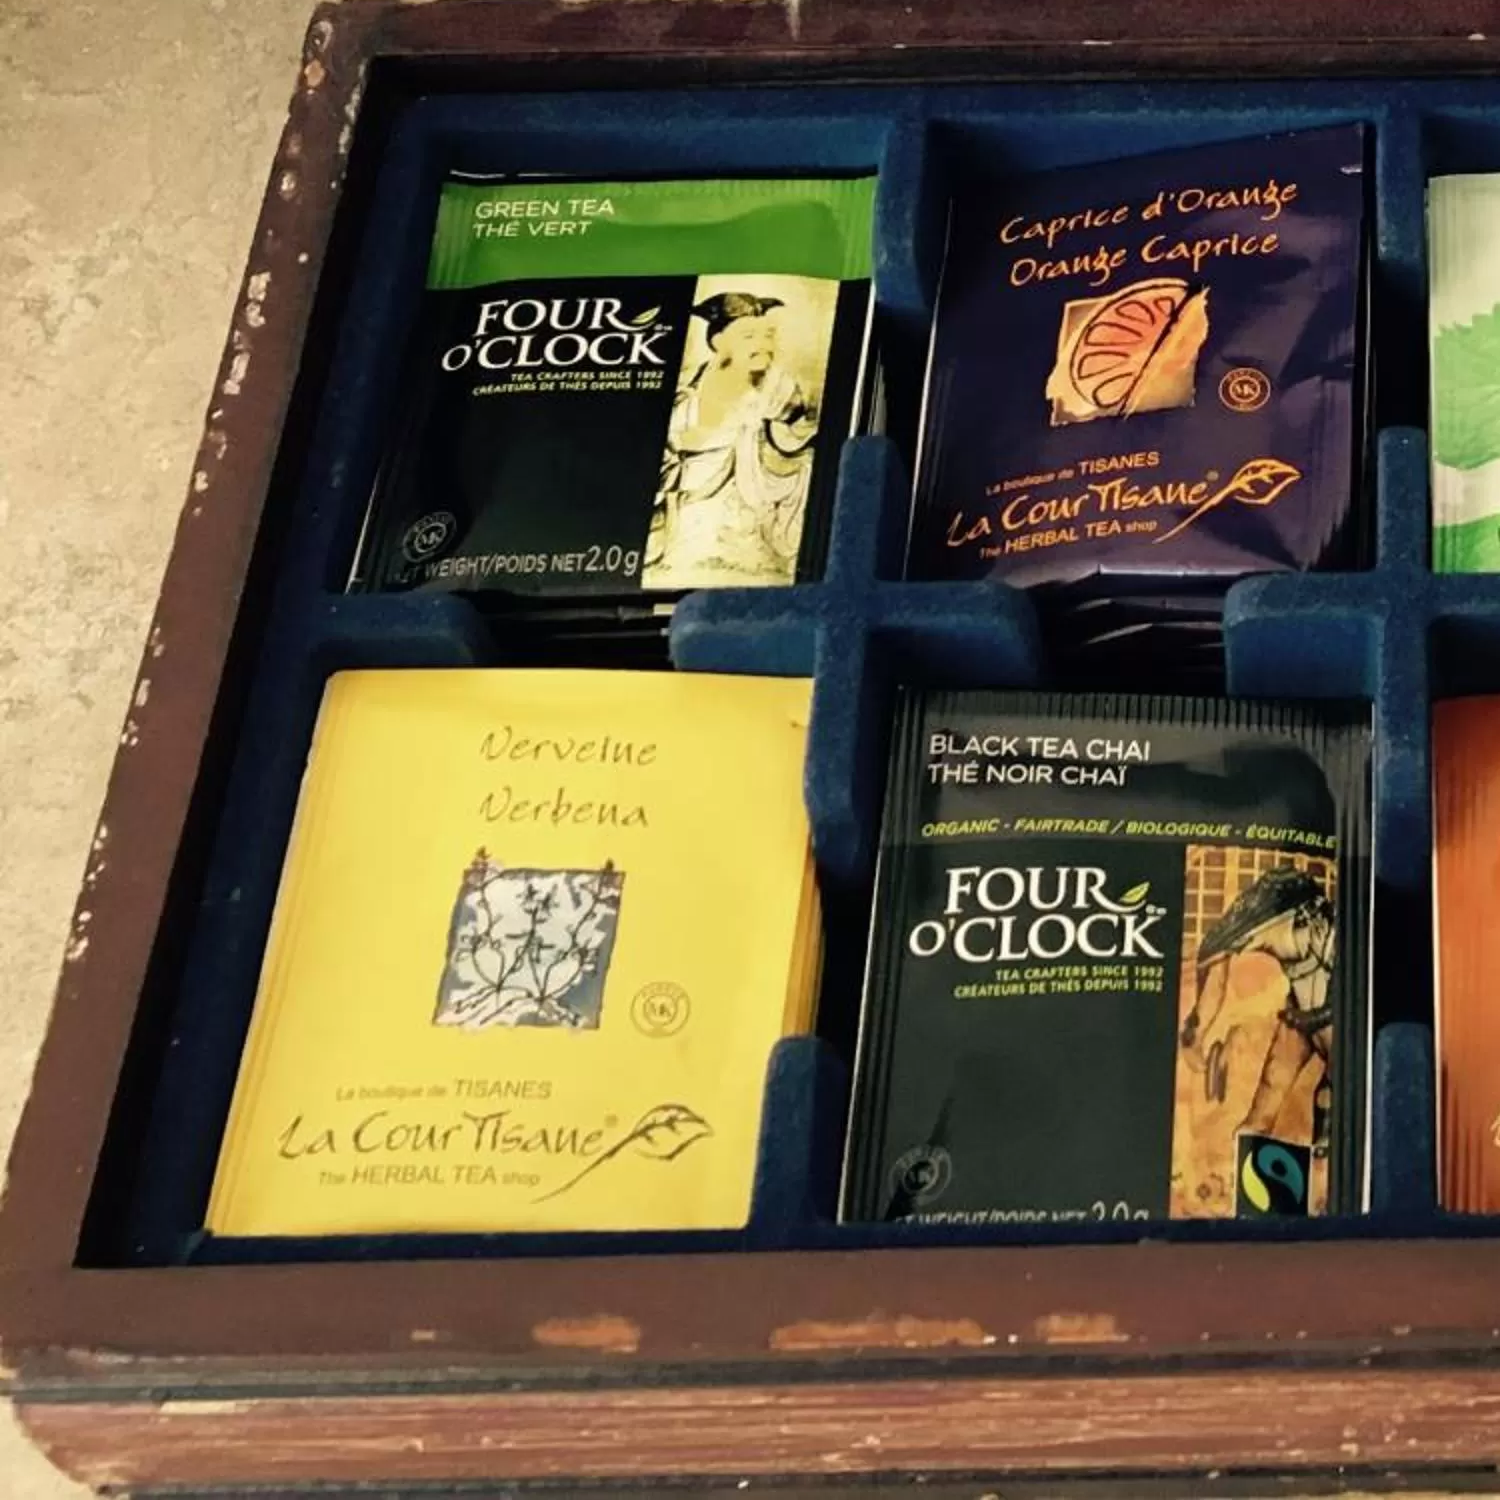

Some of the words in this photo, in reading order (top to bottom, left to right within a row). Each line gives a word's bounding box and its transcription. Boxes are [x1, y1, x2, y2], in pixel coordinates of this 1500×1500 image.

[475, 200, 559, 219] GREEN
[568, 199, 615, 215] TEA
[1000, 204, 1129, 248] Caprice
[1141, 179, 1297, 221] d'Orange
[472, 220, 520, 238] THÉ
[528, 220, 592, 237] VERT
[1010, 246, 1127, 286] Orange
[1141, 233, 1279, 273] Caprice
[473, 297, 655, 338] FOUR
[441, 332, 667, 372] O'CLOCK
[511, 373, 533, 382] TEA
[1078, 451, 1160, 475] TISANES
[947, 511, 991, 547] La
[1004, 528, 1079, 555] HERBAL
[1084, 519, 1121, 540] TEA
[1124, 519, 1157, 535] shop
[424, 553, 547, 578] WEIGHT/POIDS
[550, 553, 586, 573] NET
[480, 725, 657, 766] Verveine
[928, 734, 1019, 757] BLACK
[1025, 737, 1079, 760] TEA
[1084, 739, 1151, 761] CHAI
[927, 758, 979, 785] THÉ
[986, 763, 1054, 785] NOIR
[1060, 763, 1127, 787] CHAÏ
[479, 785, 649, 828] Verbena
[921, 819, 999, 838] ORGANIC
[1013, 818, 1111, 834] FAIRTRADE
[1126, 821, 1230, 839] BIOLOGIQUE
[1245, 823, 1336, 850] ÉQUITABLE
[944, 866, 1146, 915] FOUR
[908, 913, 1164, 963] O'CLOCK
[996, 969, 1021, 981] TEA
[1024, 966, 1087, 980] CRAFTERS
[1091, 965, 1127, 977] SINCE
[1028, 982, 1046, 994] DE
[454, 1079, 552, 1101] TISANES
[278, 1114, 335, 1160] La
[320, 1171, 346, 1186] The
[351, 1164, 445, 1185] HERBAL
[452, 1164, 497, 1185] TEA
[502, 1171, 541, 1188] shop
